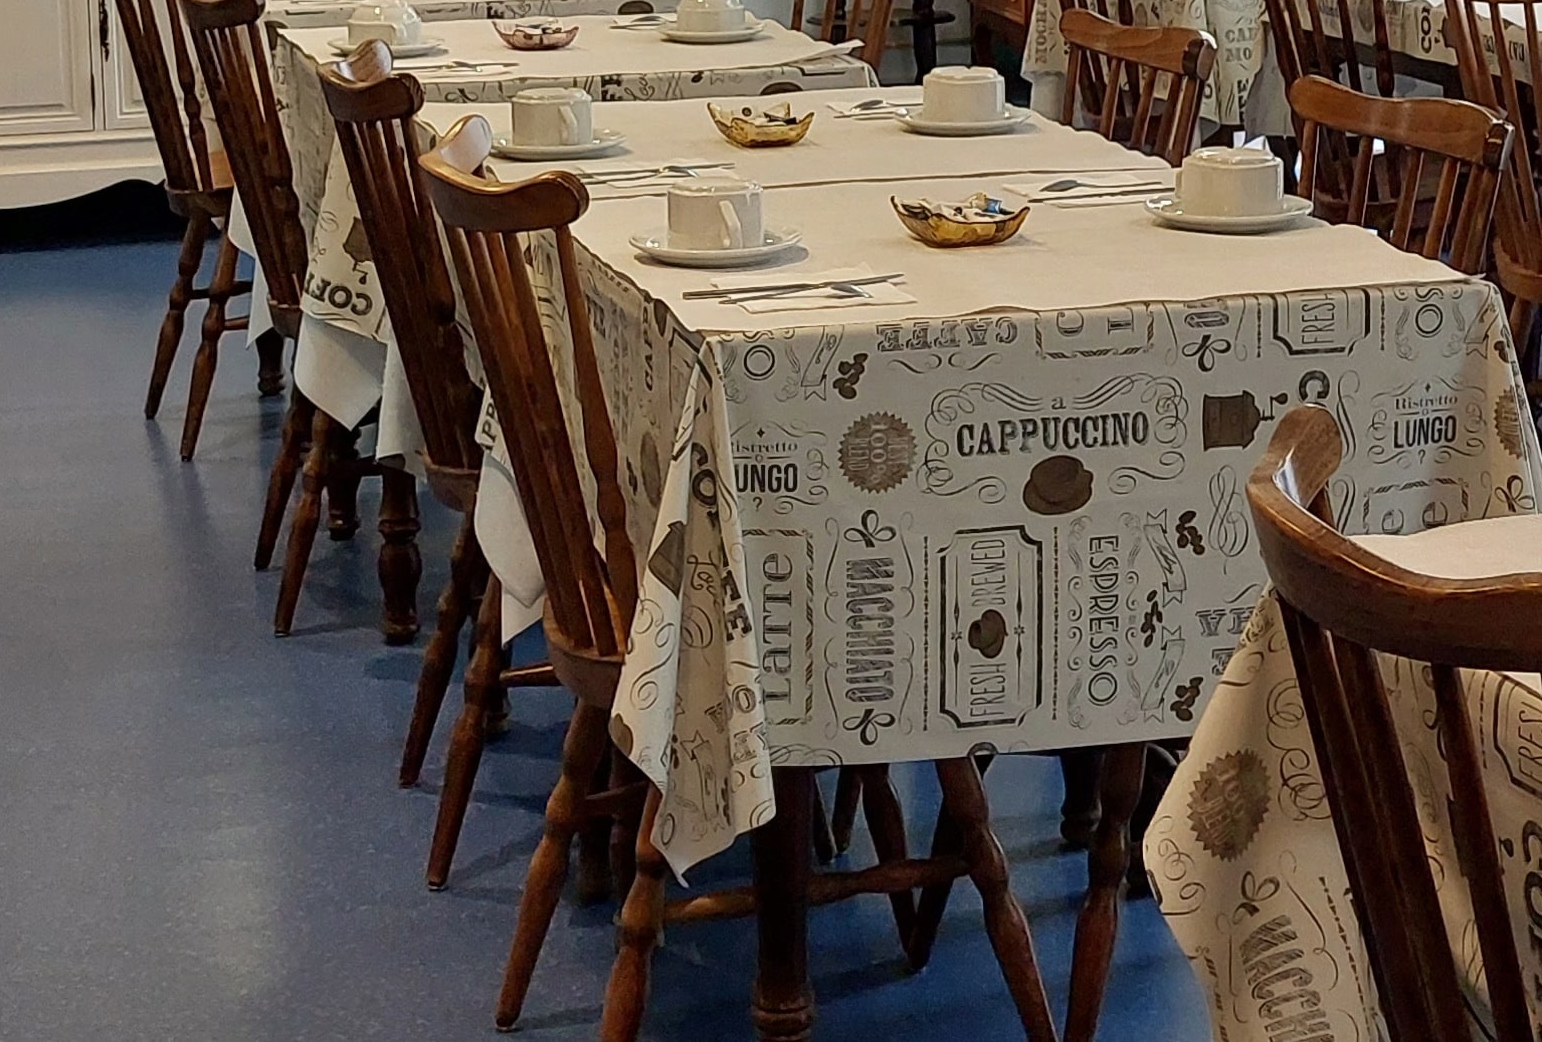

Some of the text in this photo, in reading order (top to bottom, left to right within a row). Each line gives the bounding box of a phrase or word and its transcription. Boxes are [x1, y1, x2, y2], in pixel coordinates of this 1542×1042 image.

[735, 462, 799, 494] UNGO
[957, 410, 1151, 458] CAPPUCCINO
[1393, 414, 1458, 450] LUNGO
[844, 556, 896, 704] MACCHIATO
[969, 537, 1007, 718] FRESH BREWED
[1087, 534, 1120, 706] ESPRESSO
